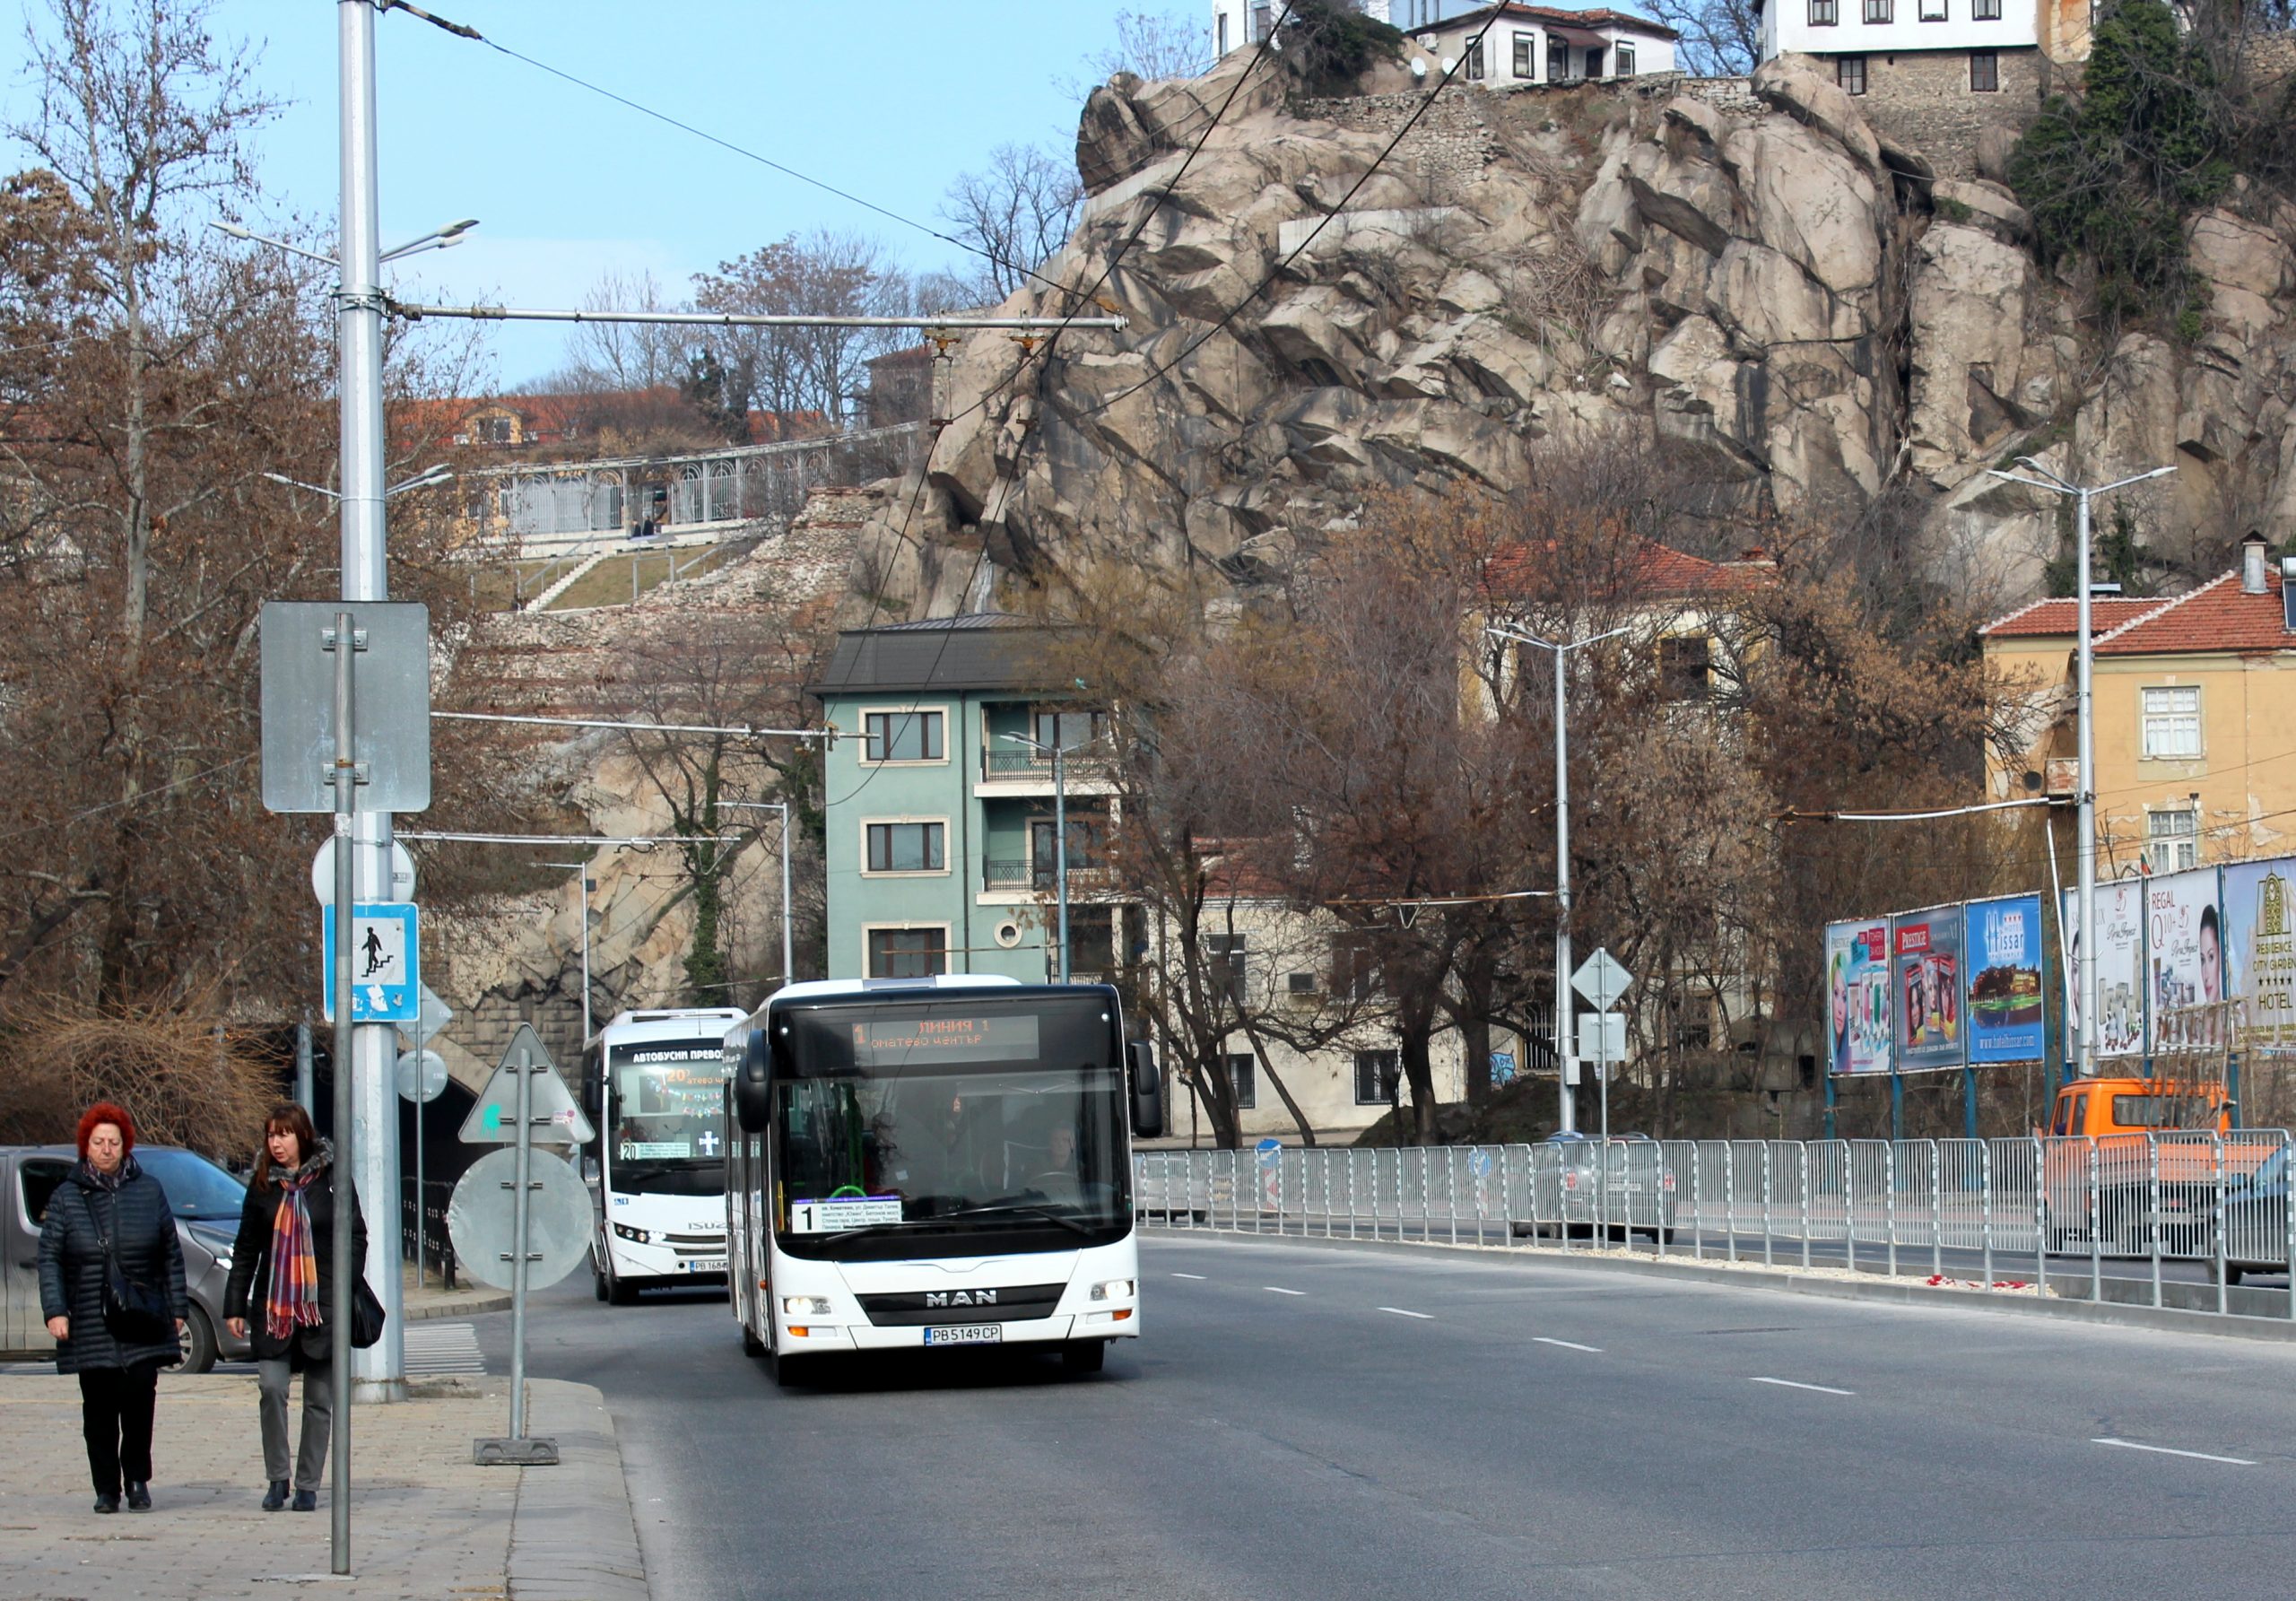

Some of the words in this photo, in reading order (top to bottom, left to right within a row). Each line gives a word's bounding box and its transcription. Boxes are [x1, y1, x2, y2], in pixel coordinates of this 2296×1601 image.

[2152, 891, 2175, 909] REGAL
[1902, 931, 1926, 950] PRESTIGE
[1985, 913, 2023, 953] Hissar
[2253, 959, 2268, 972] CITY
[2258, 992, 2292, 1010] HOTEL
[854, 1024, 865, 1044] 1
[919, 1020, 973, 1033] ЛИНИЯ
[982, 1020, 989, 1031] 1
[633, 1050, 688, 1063] АВТОБУСНИ
[666, 1069, 686, 1082] 20
[622, 1144, 636, 1160] 20
[801, 1206, 813, 1231] 1
[695, 1261, 706, 1270] PB
[926, 1290, 996, 1307] MAN
[933, 1329, 949, 1342] PB
[951, 1328, 980, 1340] 5149
[982, 1327, 998, 1339] CP
